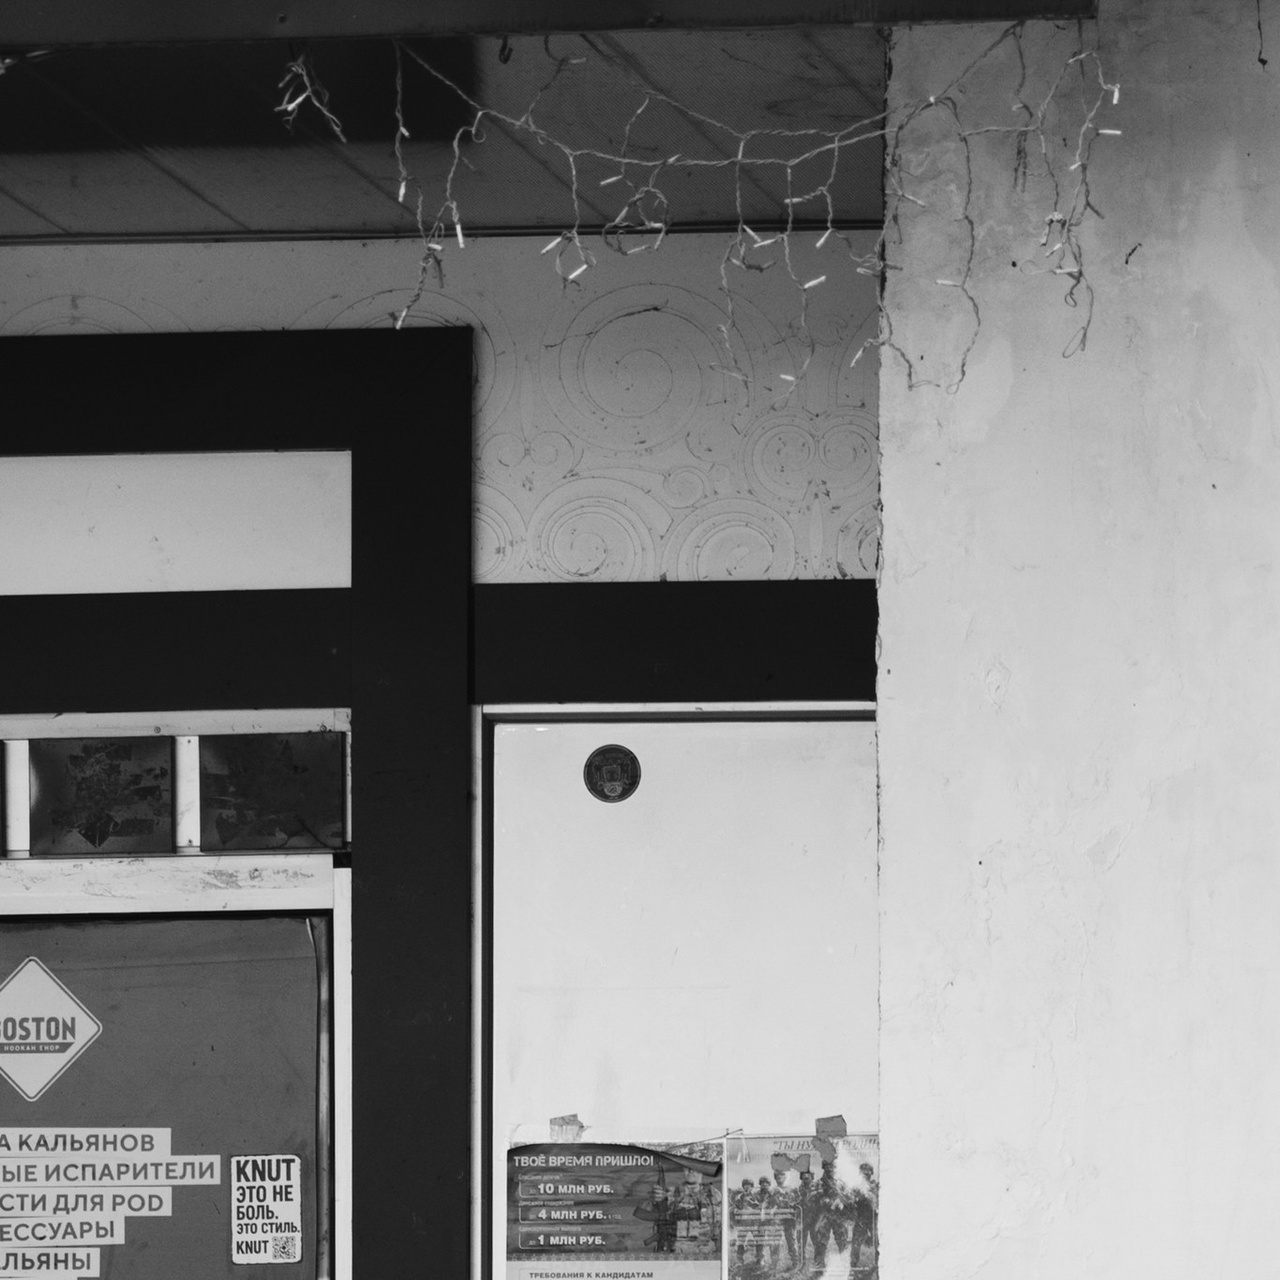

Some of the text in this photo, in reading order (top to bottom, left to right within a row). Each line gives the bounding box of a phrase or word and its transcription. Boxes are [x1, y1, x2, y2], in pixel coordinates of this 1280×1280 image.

[0, 1016, 76, 1041] OSTON
[18, 1134, 155, 1152] КАЛЬЯНОВ
[513, 1154, 654, 1167] ТВОЁ ВРЕМЯ ПРИШЛО!
[2, 1162, 215, 1182] ЫЕ ИСПАРИТЕЛИ
[236, 1158, 296, 1182] KNUT
[236, 1185, 293, 1203] ЭТО НЕ
[538, 1183, 554, 1194] 10
[558, 1184, 585, 1194] МЛН
[588, 1184, 615, 1194] РУБ.
[0, 1194, 163, 1215] СТИ ДЛЯ POD
[236, 1205, 278, 1220] БОЛЬ.
[538, 1209, 547, 1219] 4
[551, 1210, 577, 1219] МЛН
[580, 1210, 607, 1219] РУБ.
[0, 1221, 114, 1241] ЕССУАРЫ
[236, 1222, 300, 1234] ЭТО СТИЛЬ.
[236, 1240, 269, 1254] KNUT
[538, 1235, 544, 1245] 1
[550, 1235, 576, 1245] МЛН
[579, 1235, 606, 1245] РУБ.
[0, 1253, 91, 1271] ЛЬЯНЫ
[595, 1272, 653, 1280] КАНДИДАТАМ
